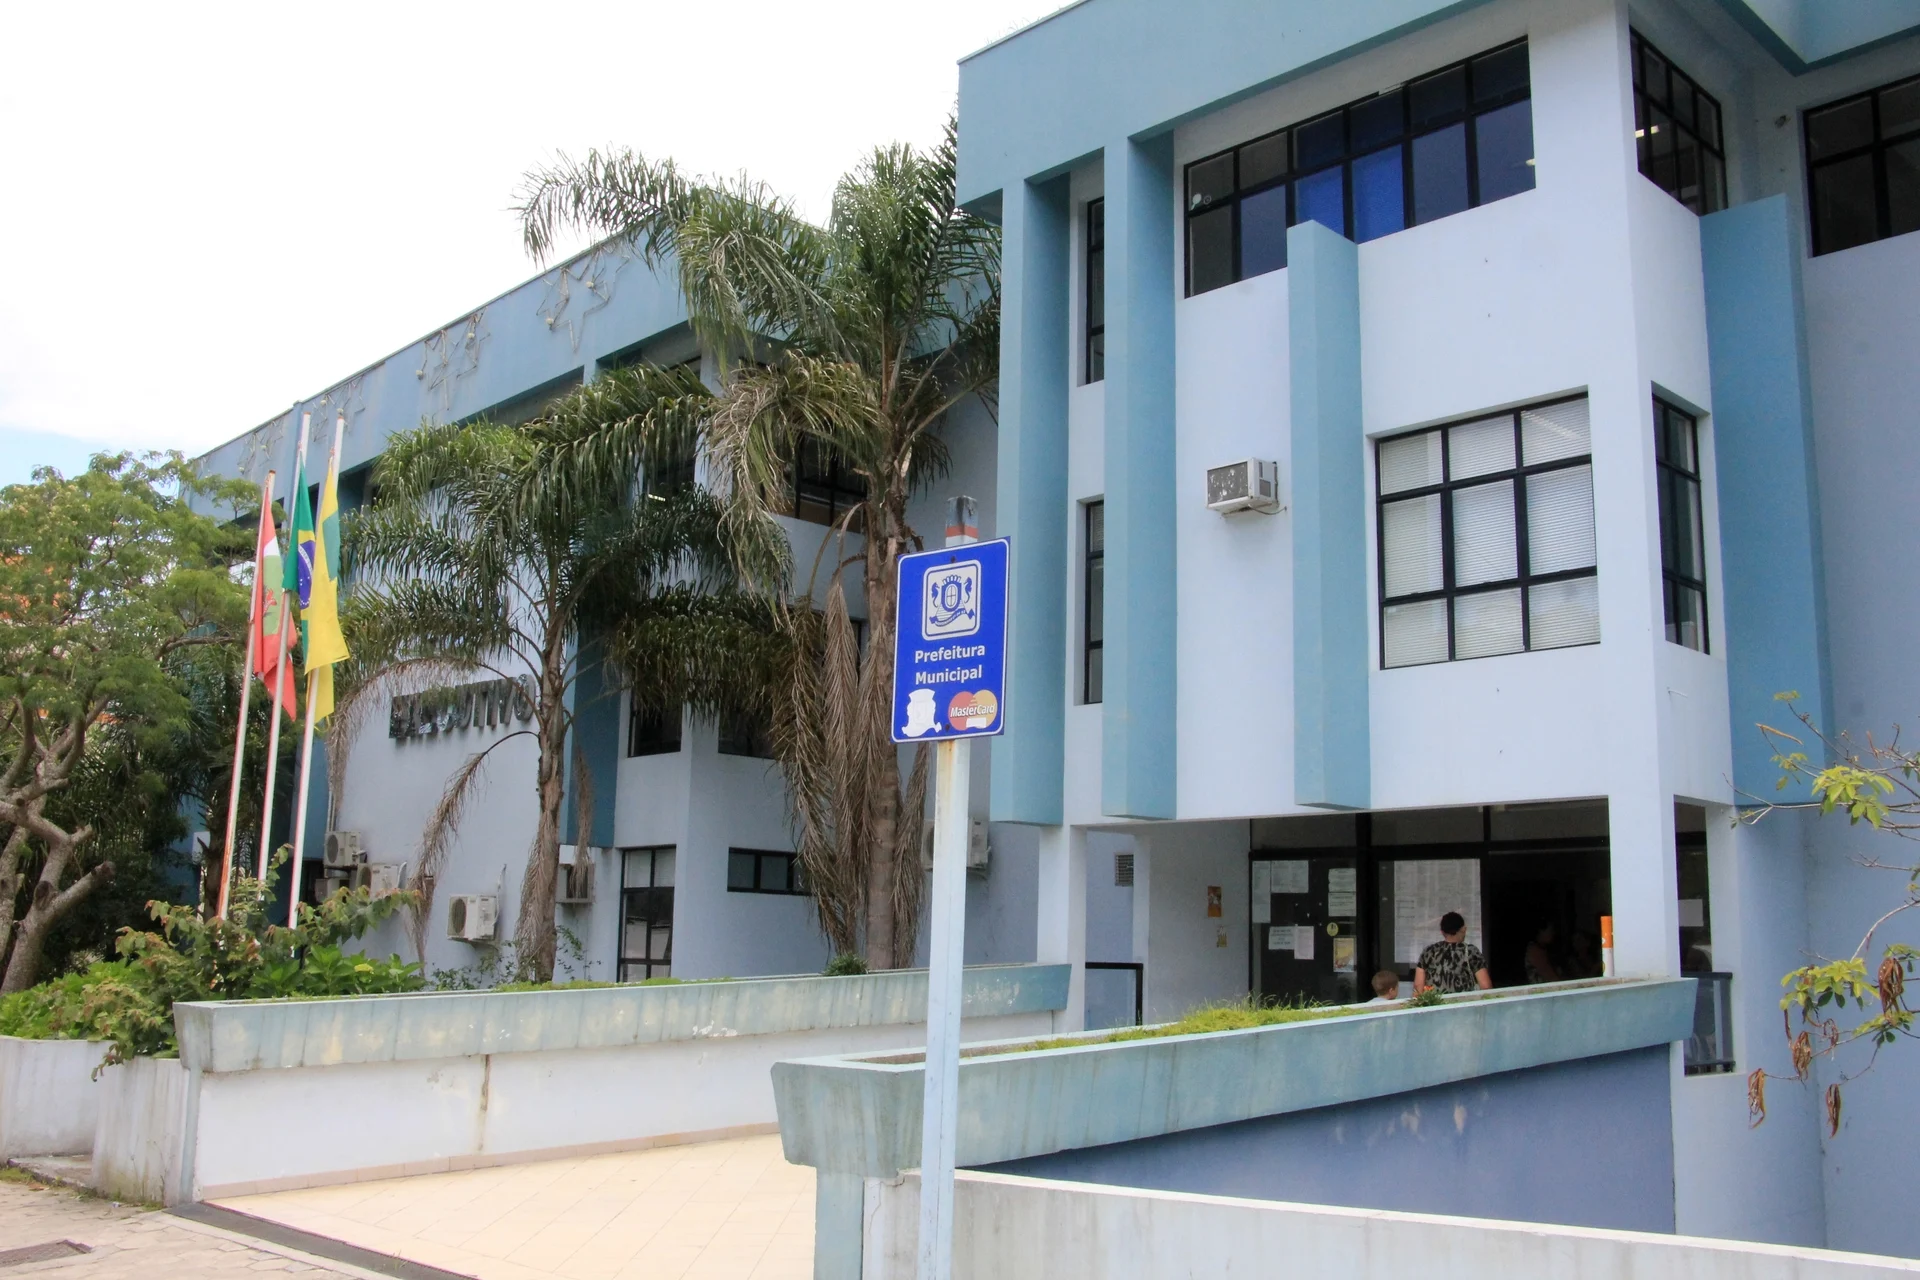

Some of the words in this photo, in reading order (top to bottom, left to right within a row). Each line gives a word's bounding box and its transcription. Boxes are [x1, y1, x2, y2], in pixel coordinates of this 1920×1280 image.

[914, 645, 985, 663] Prefeitura
[915, 664, 983, 685] Municipal
[950, 704, 995, 717] MasterCard
